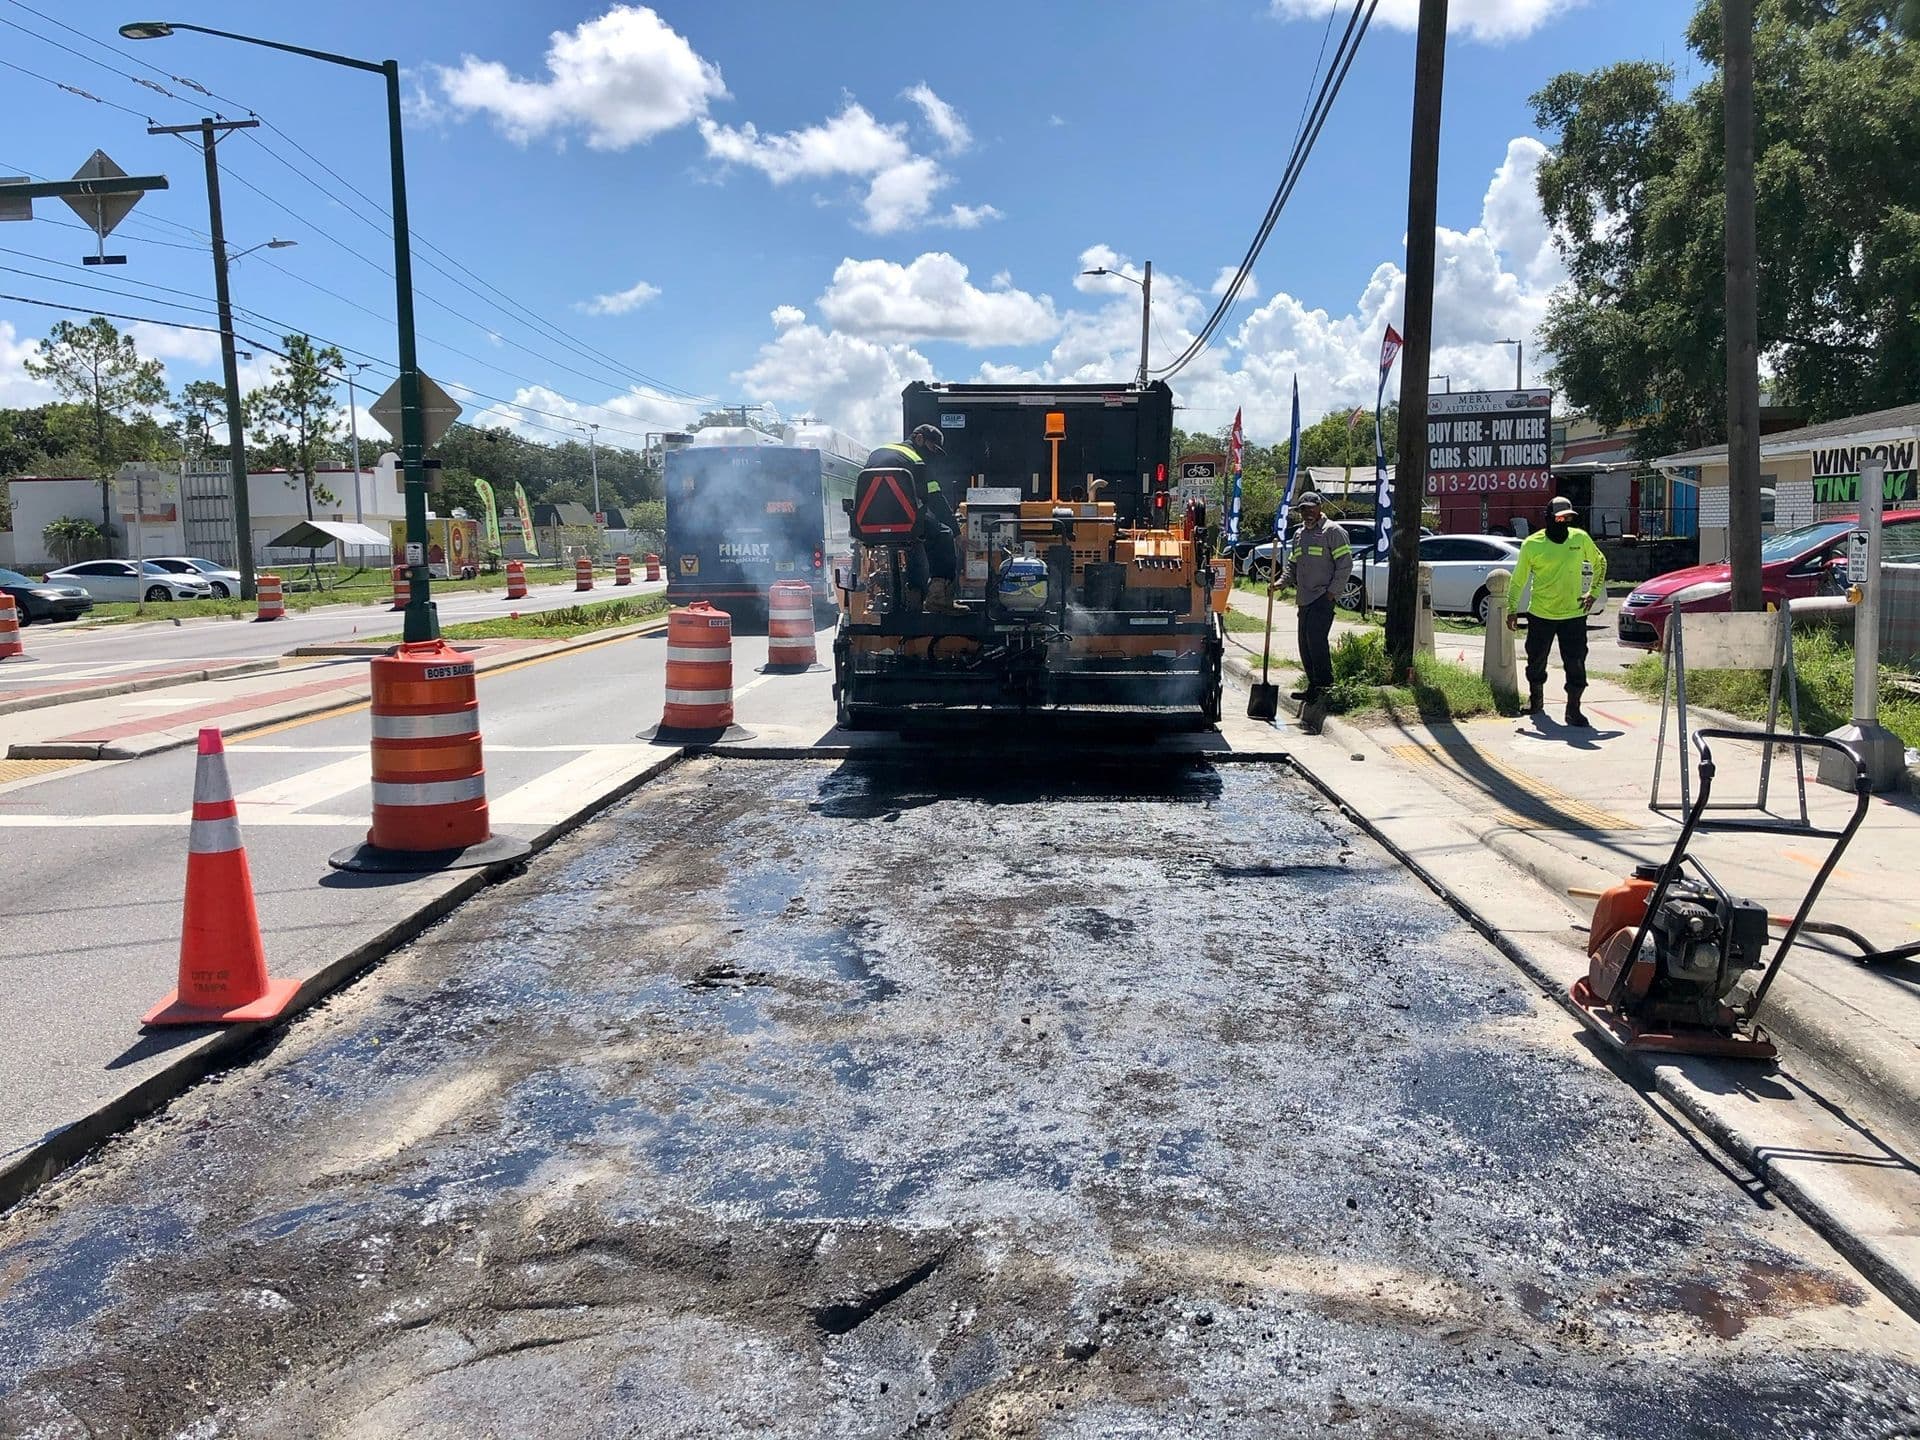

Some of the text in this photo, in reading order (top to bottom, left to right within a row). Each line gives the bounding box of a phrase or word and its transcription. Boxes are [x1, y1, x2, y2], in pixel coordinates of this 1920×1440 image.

[1447, 403, 1503, 413] AUTOSALES
[1458, 394, 1492, 404] MERX
[1427, 422, 1451, 444] BUY
[1453, 420, 1483, 443] HERE
[1492, 419, 1516, 441] PAY
[1516, 417, 1546, 440] HERE
[1430, 447, 1461, 469] CARS
[1468, 445, 1493, 467] SUV
[1500, 443, 1547, 466] TRUCKS
[1812, 441, 1914, 475] WINDOW
[1428, 471, 1549, 492] 813-203-8669
[1813, 471, 1909, 502] TINTNG
[427, 666, 451, 678] BOB'S
